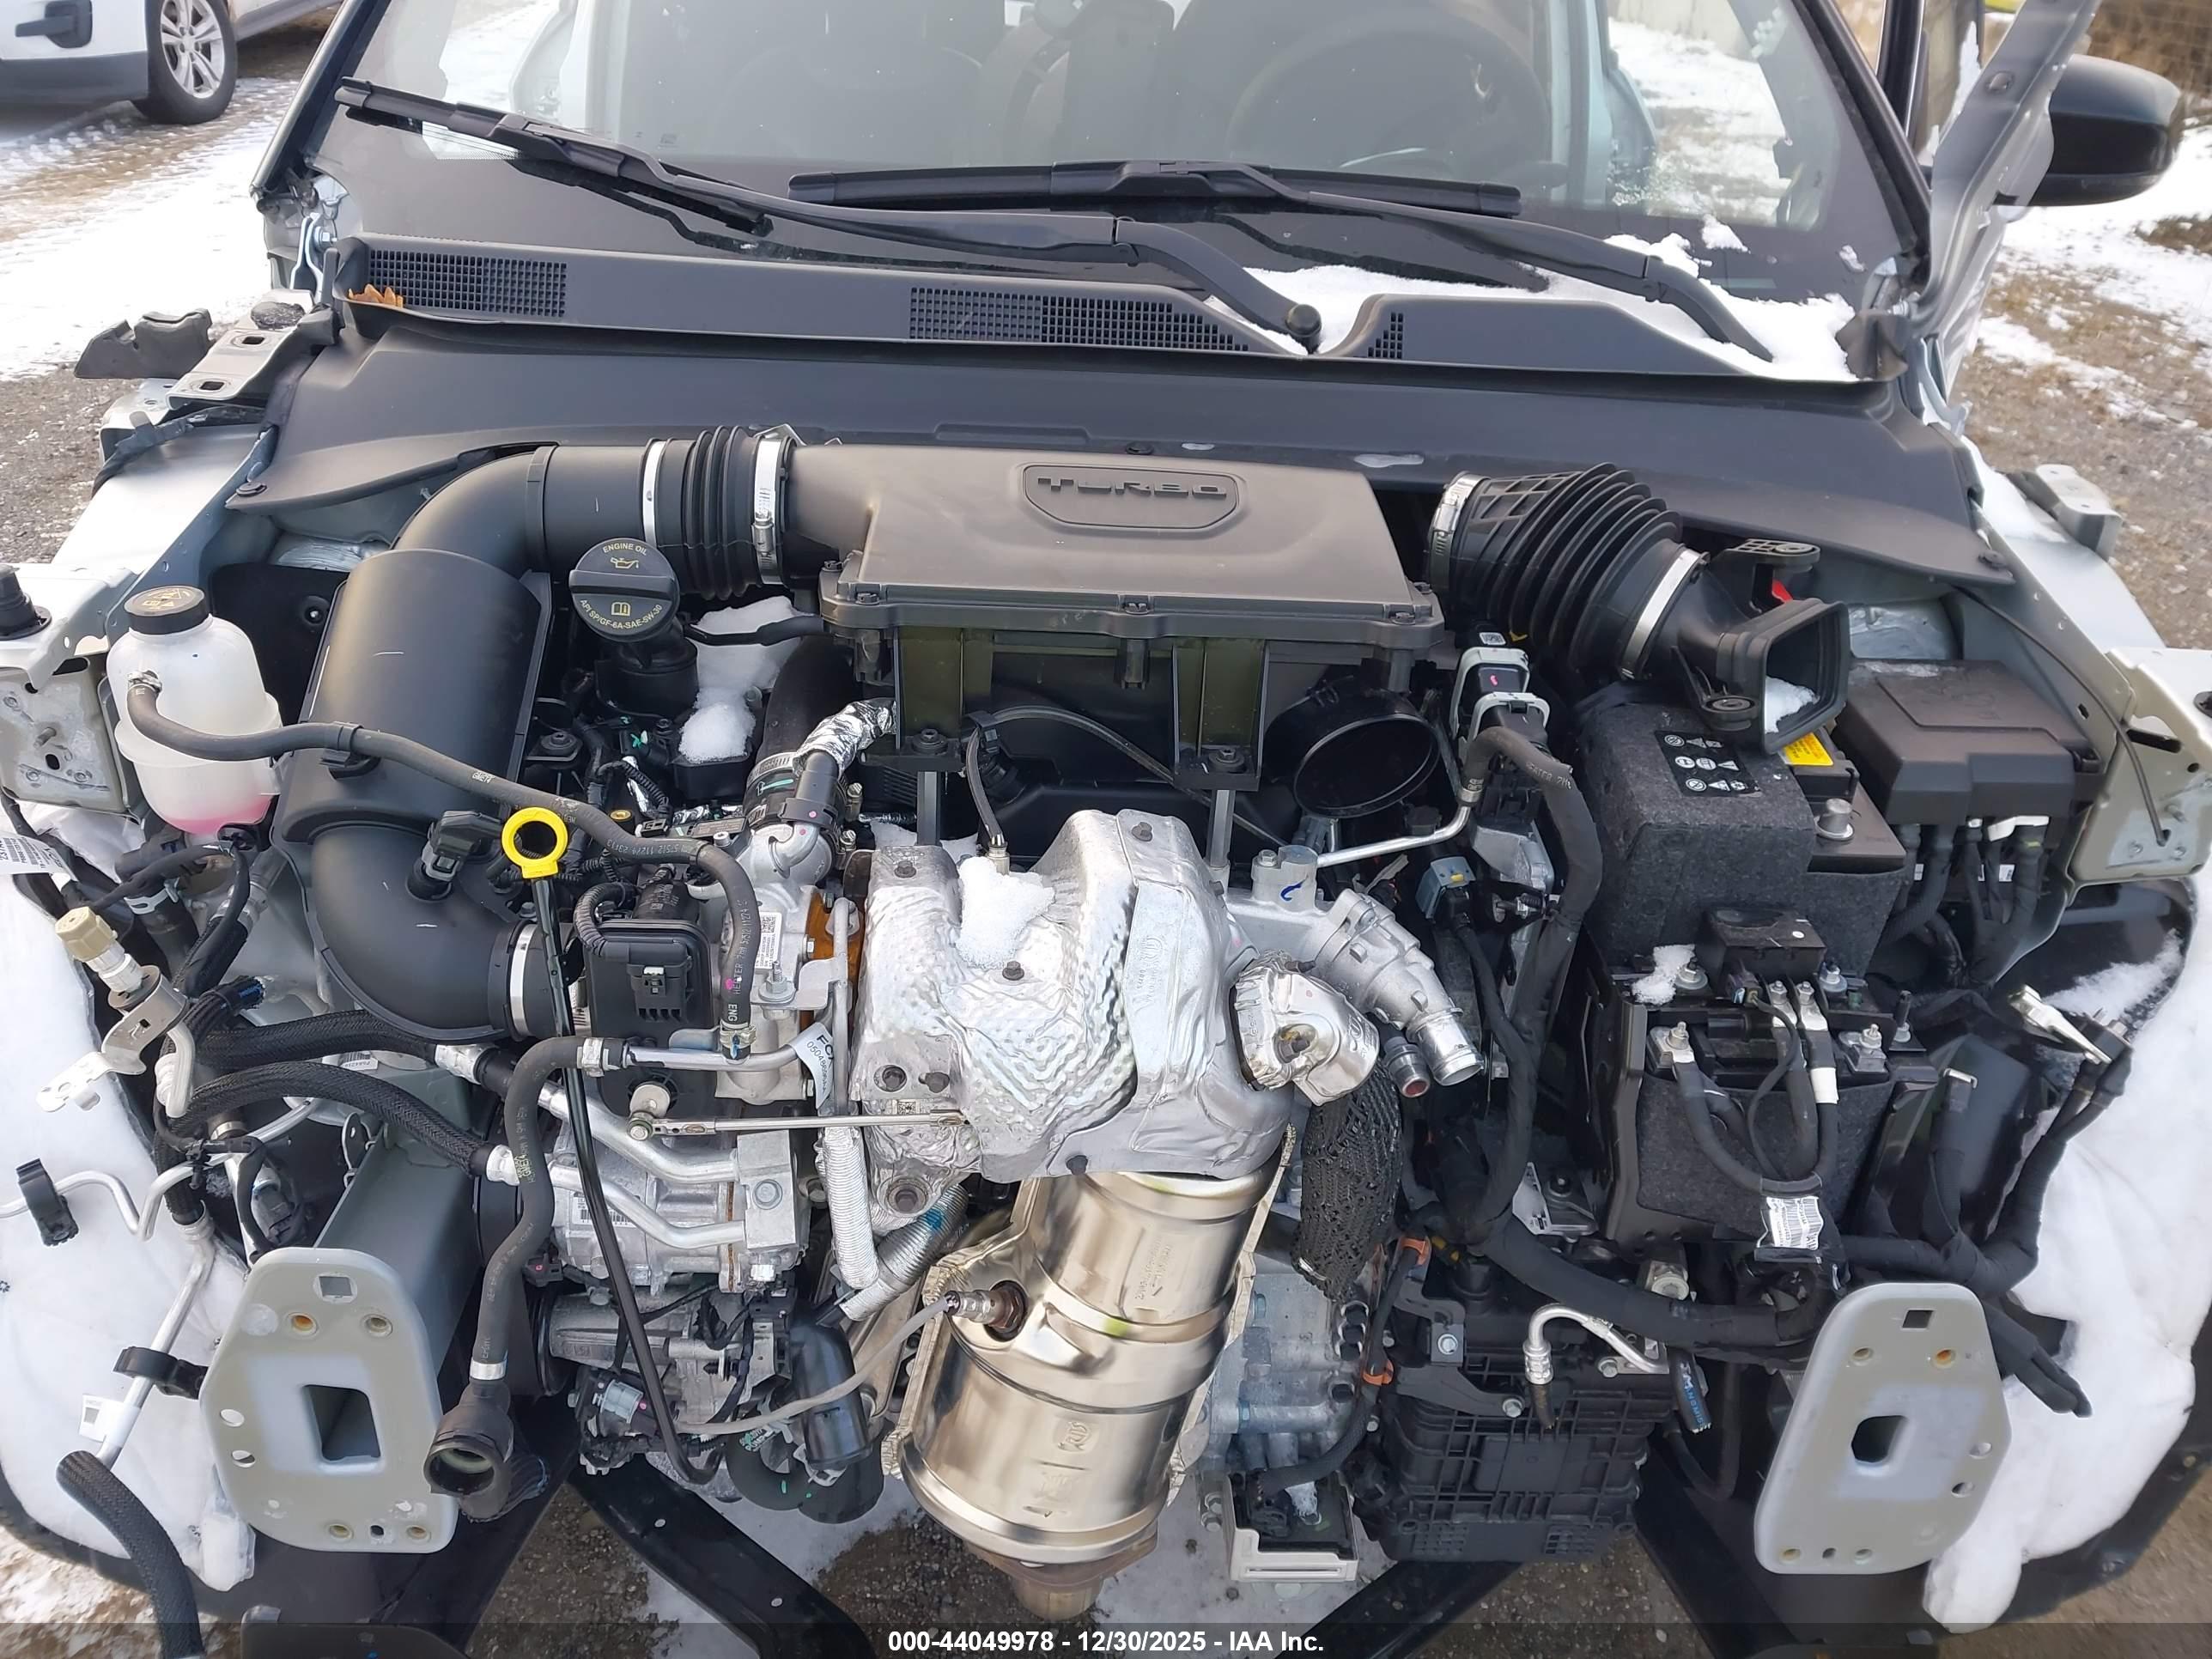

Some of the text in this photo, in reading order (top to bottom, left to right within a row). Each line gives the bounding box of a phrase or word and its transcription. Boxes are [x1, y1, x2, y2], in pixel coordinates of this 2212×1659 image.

[1037, 477, 1228, 499] TURBO
[602, 542, 648, 556] ENGINE OIL
[580, 599, 592, 614] API
[727, 1003, 738, 1022] ENG
[816, 1034, 835, 1060] FC
